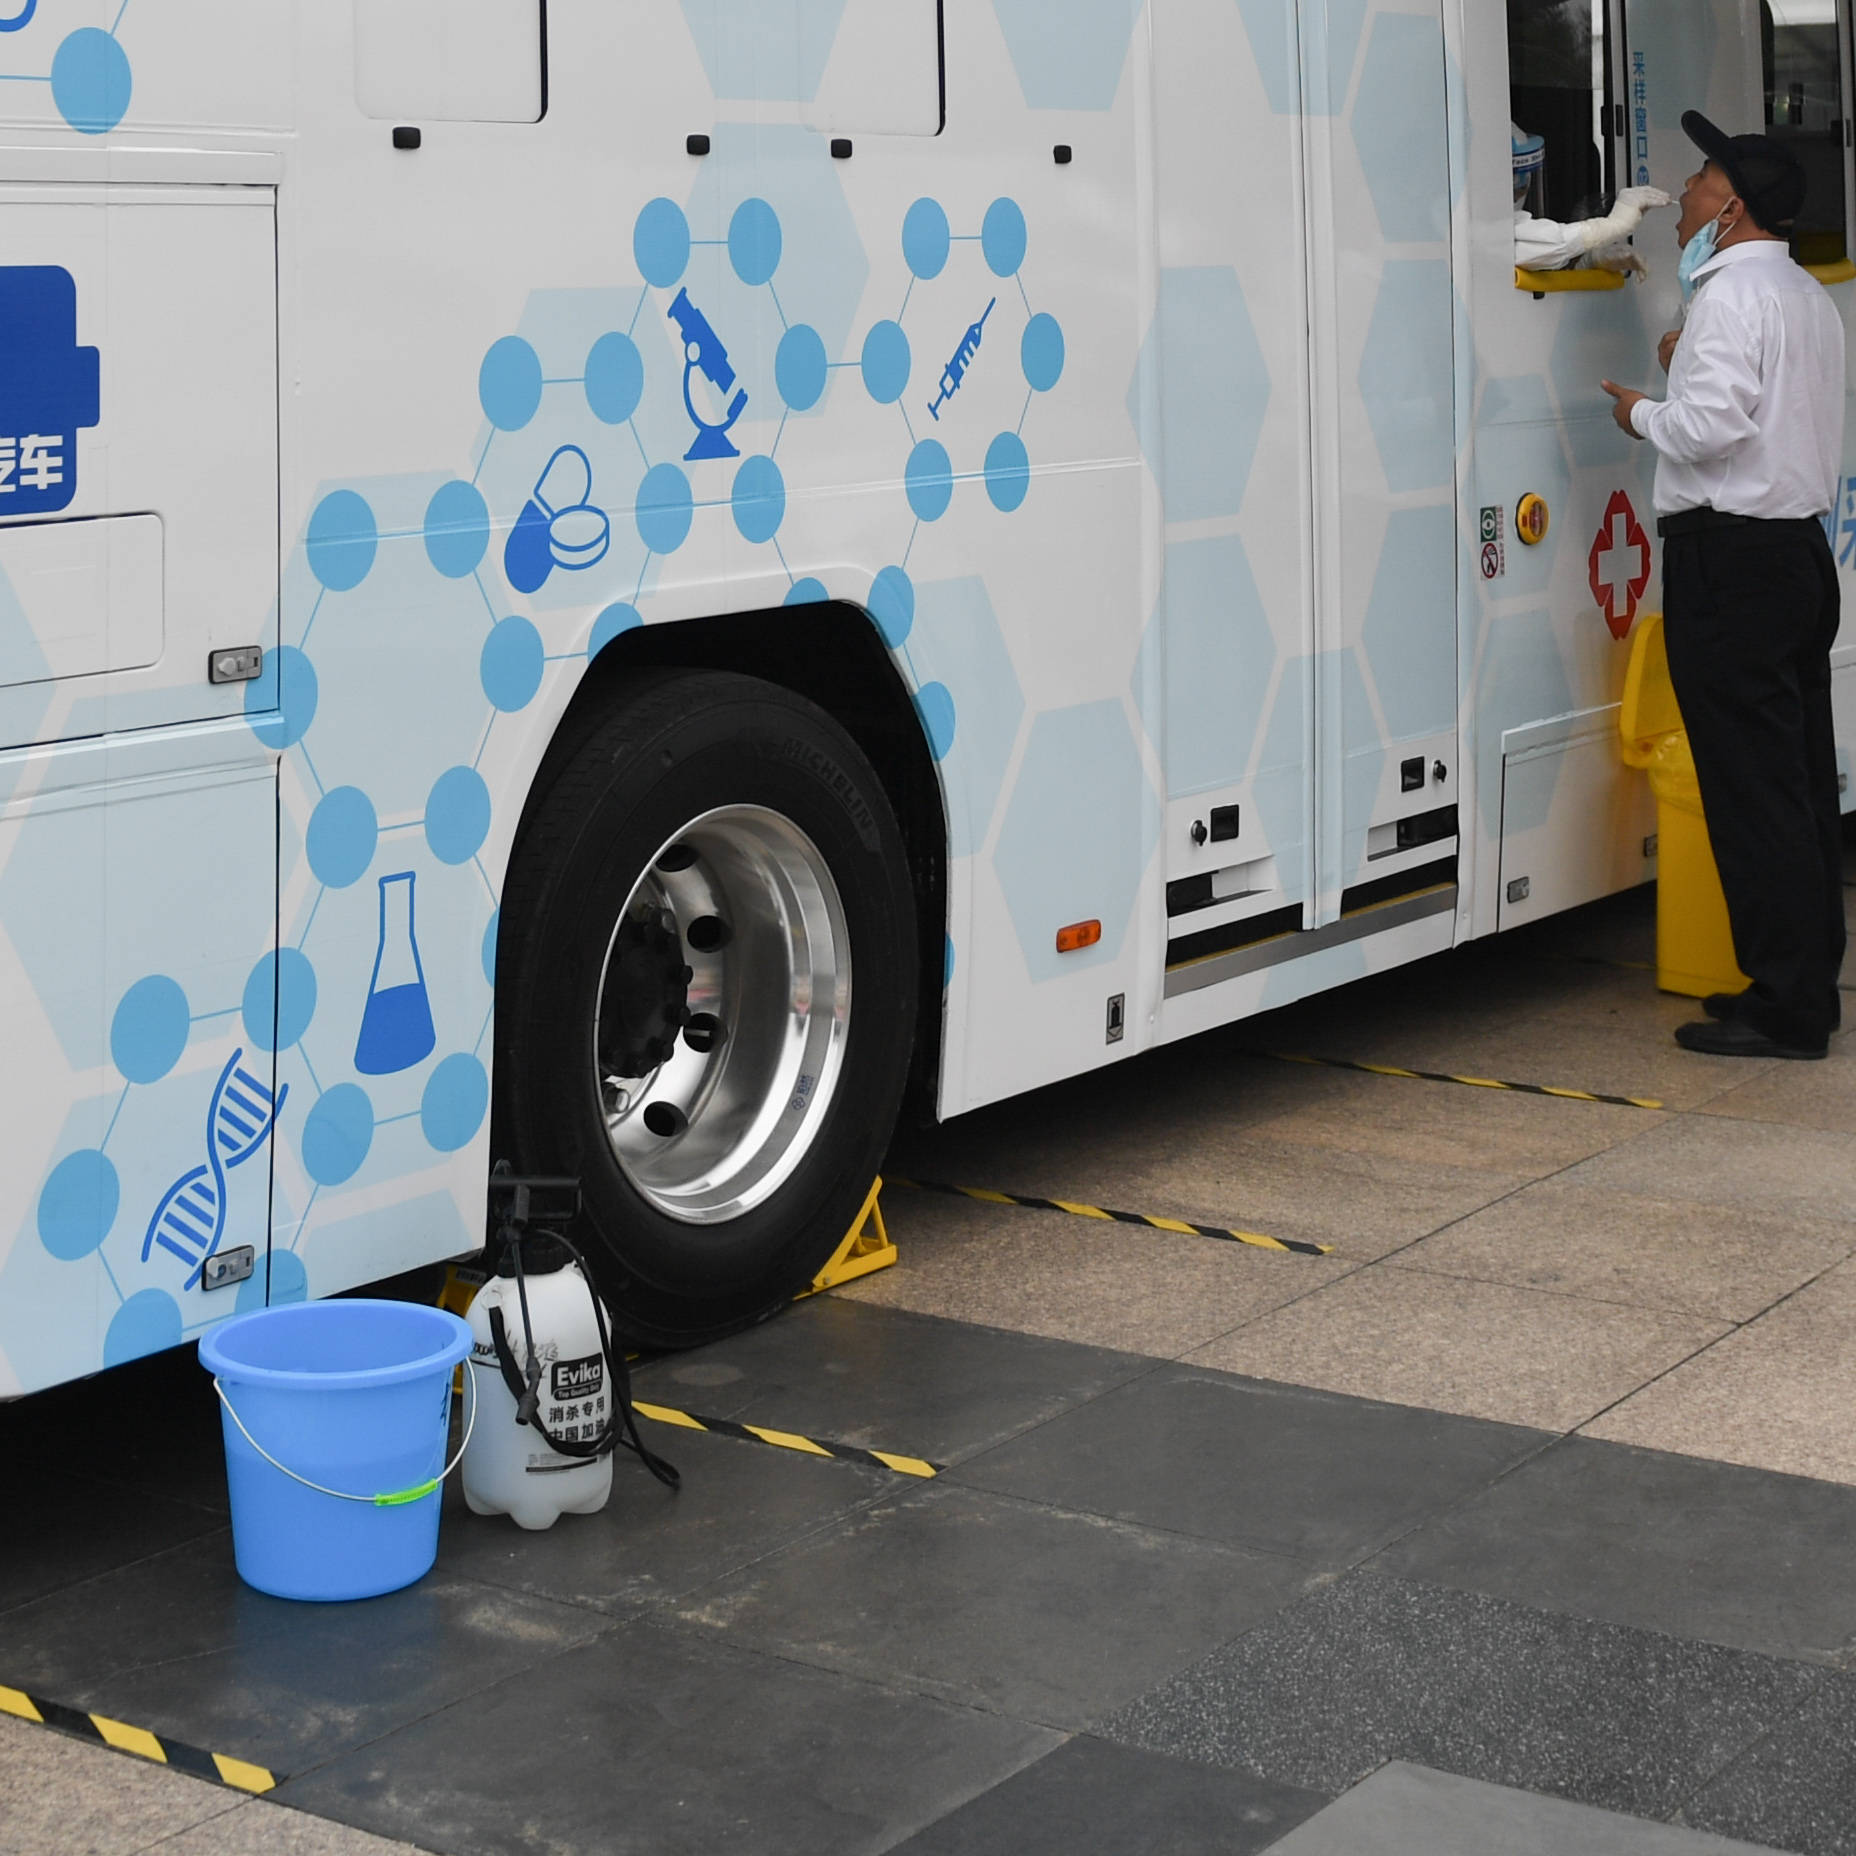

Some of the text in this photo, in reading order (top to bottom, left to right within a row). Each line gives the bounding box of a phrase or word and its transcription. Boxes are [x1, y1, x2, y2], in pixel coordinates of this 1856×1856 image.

[784, 736, 875, 830] MICHELIN
[557, 1362, 601, 1386] Evika
[549, 1396, 605, 1423] 消杀专用
